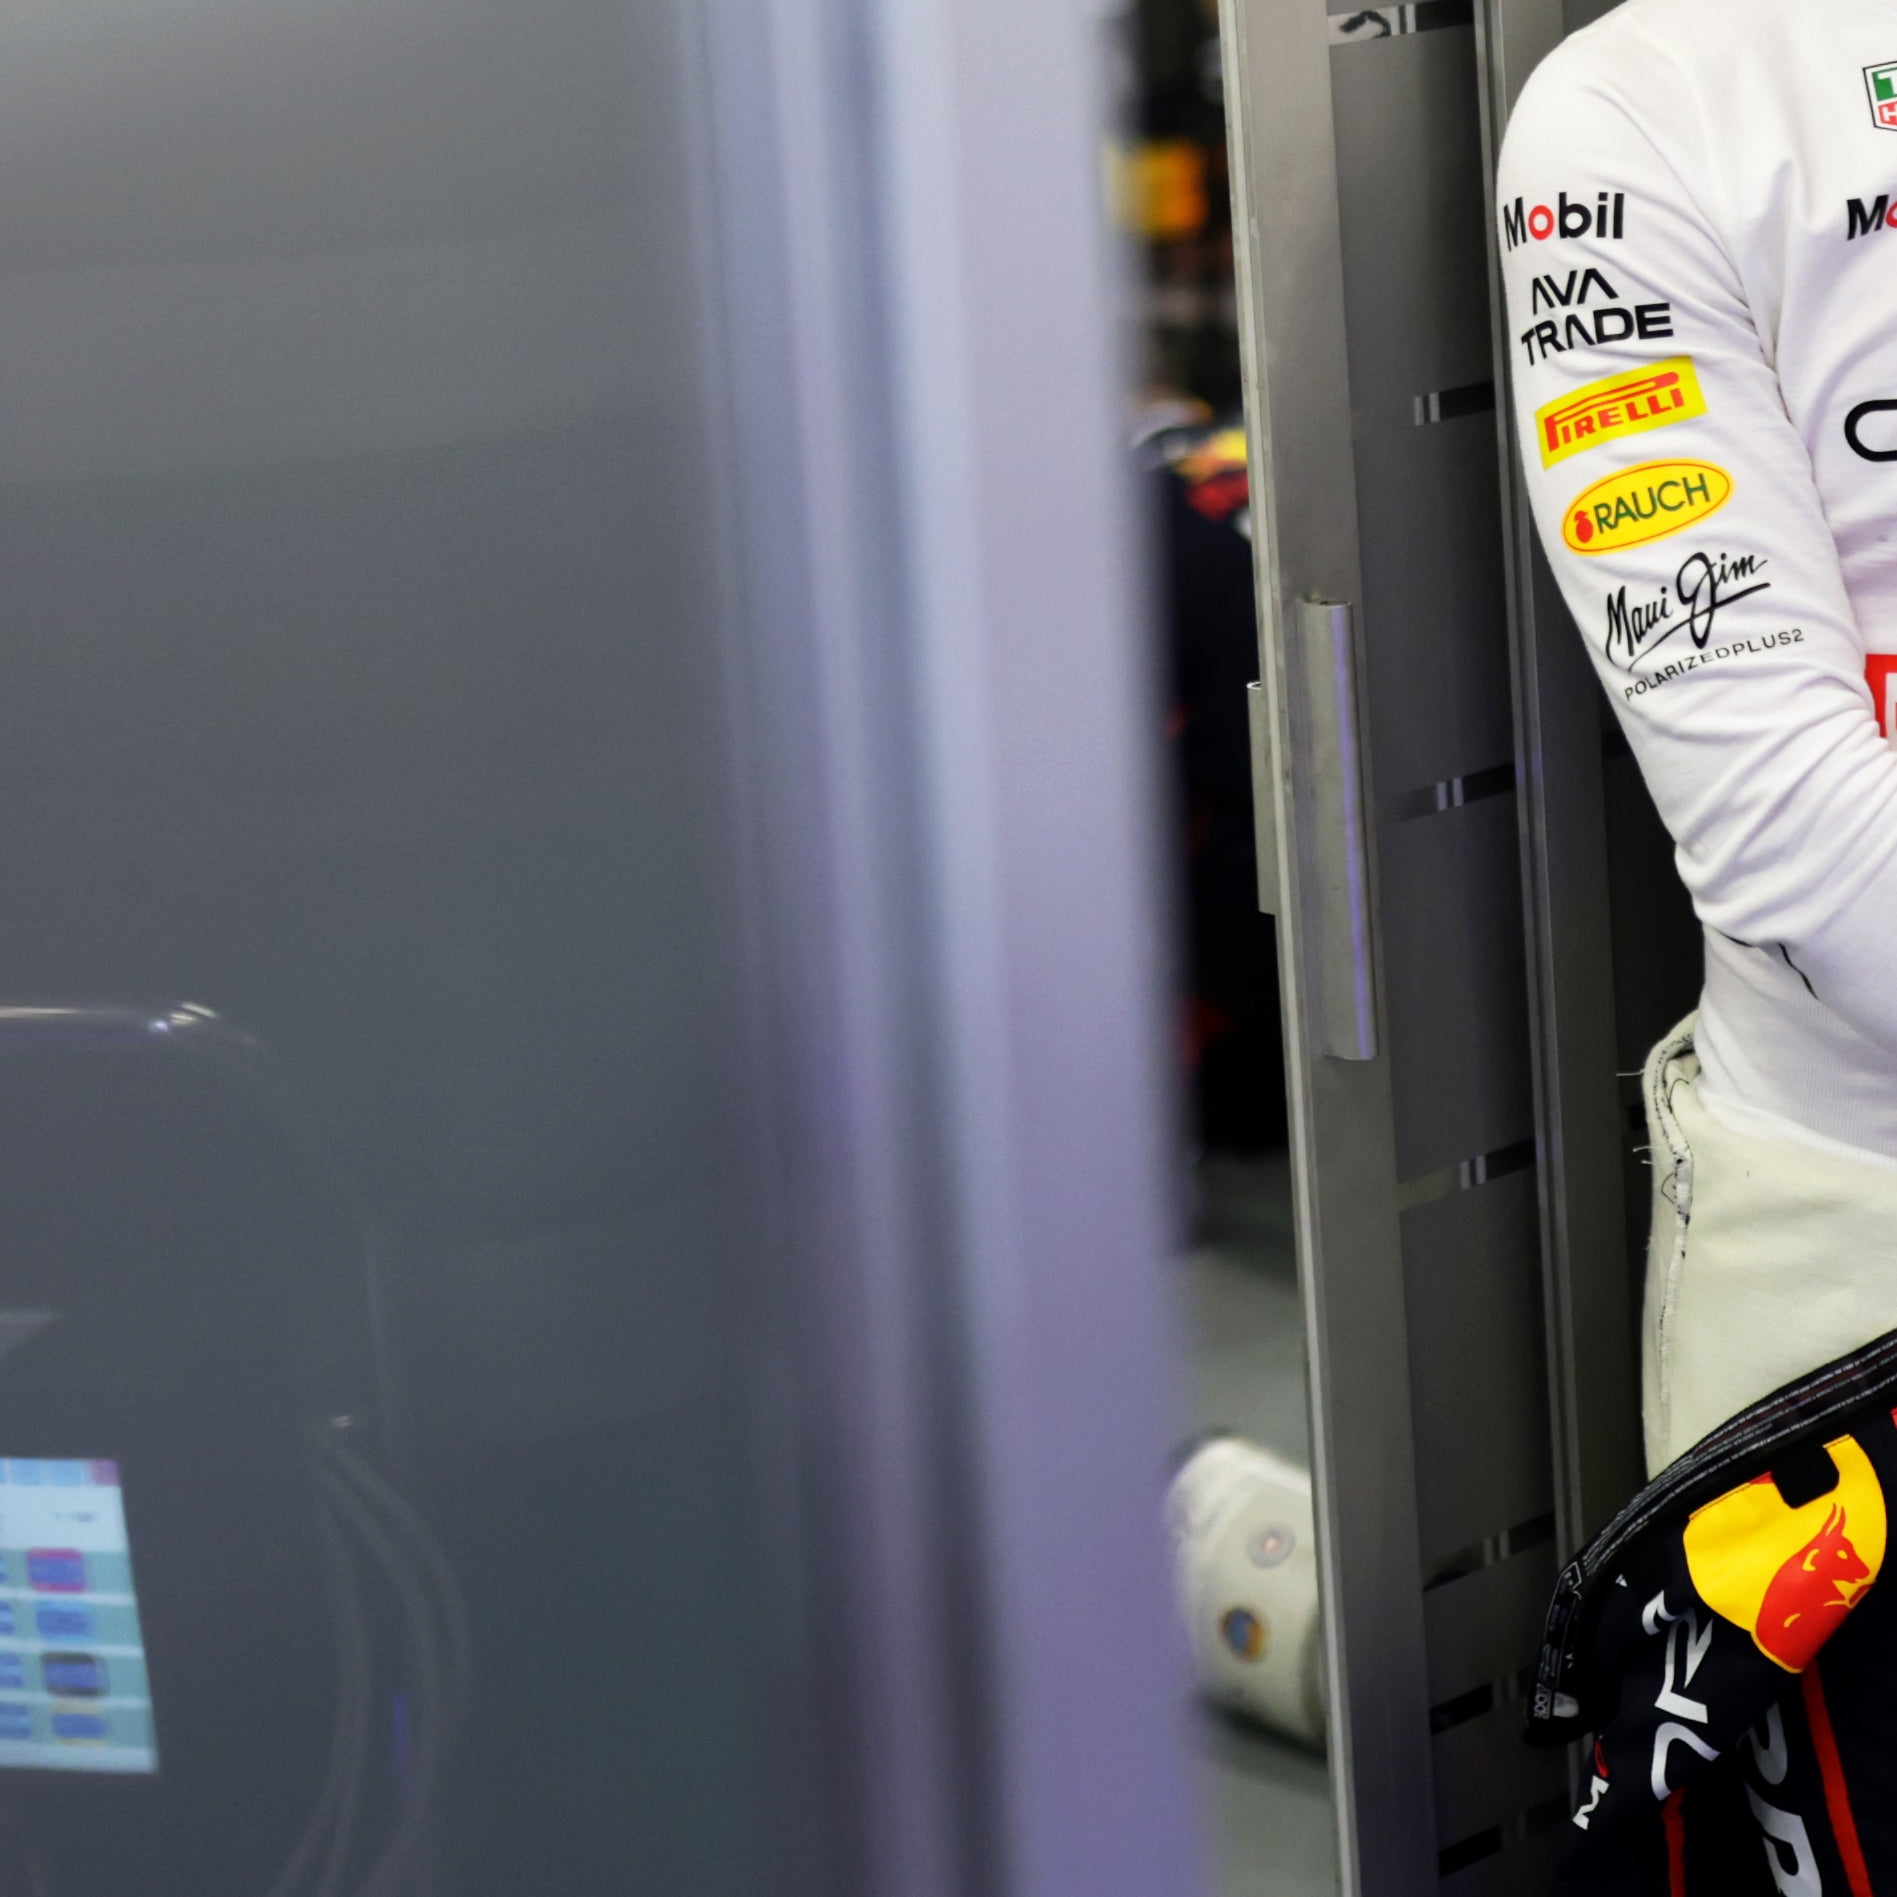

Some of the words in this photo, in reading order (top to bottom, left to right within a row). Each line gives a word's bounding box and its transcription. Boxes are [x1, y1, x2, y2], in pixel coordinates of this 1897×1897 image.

[1503, 191, 1624, 252] Mobil
[1532, 267, 1619, 316] AVA
[1520, 302, 1674, 366] TRADE
[1544, 371, 1685, 452] PIRELLI
[1593, 473, 1711, 535] RAUCH
[1606, 585, 1673, 667] Maui
[1676, 551, 1769, 649] Jim
